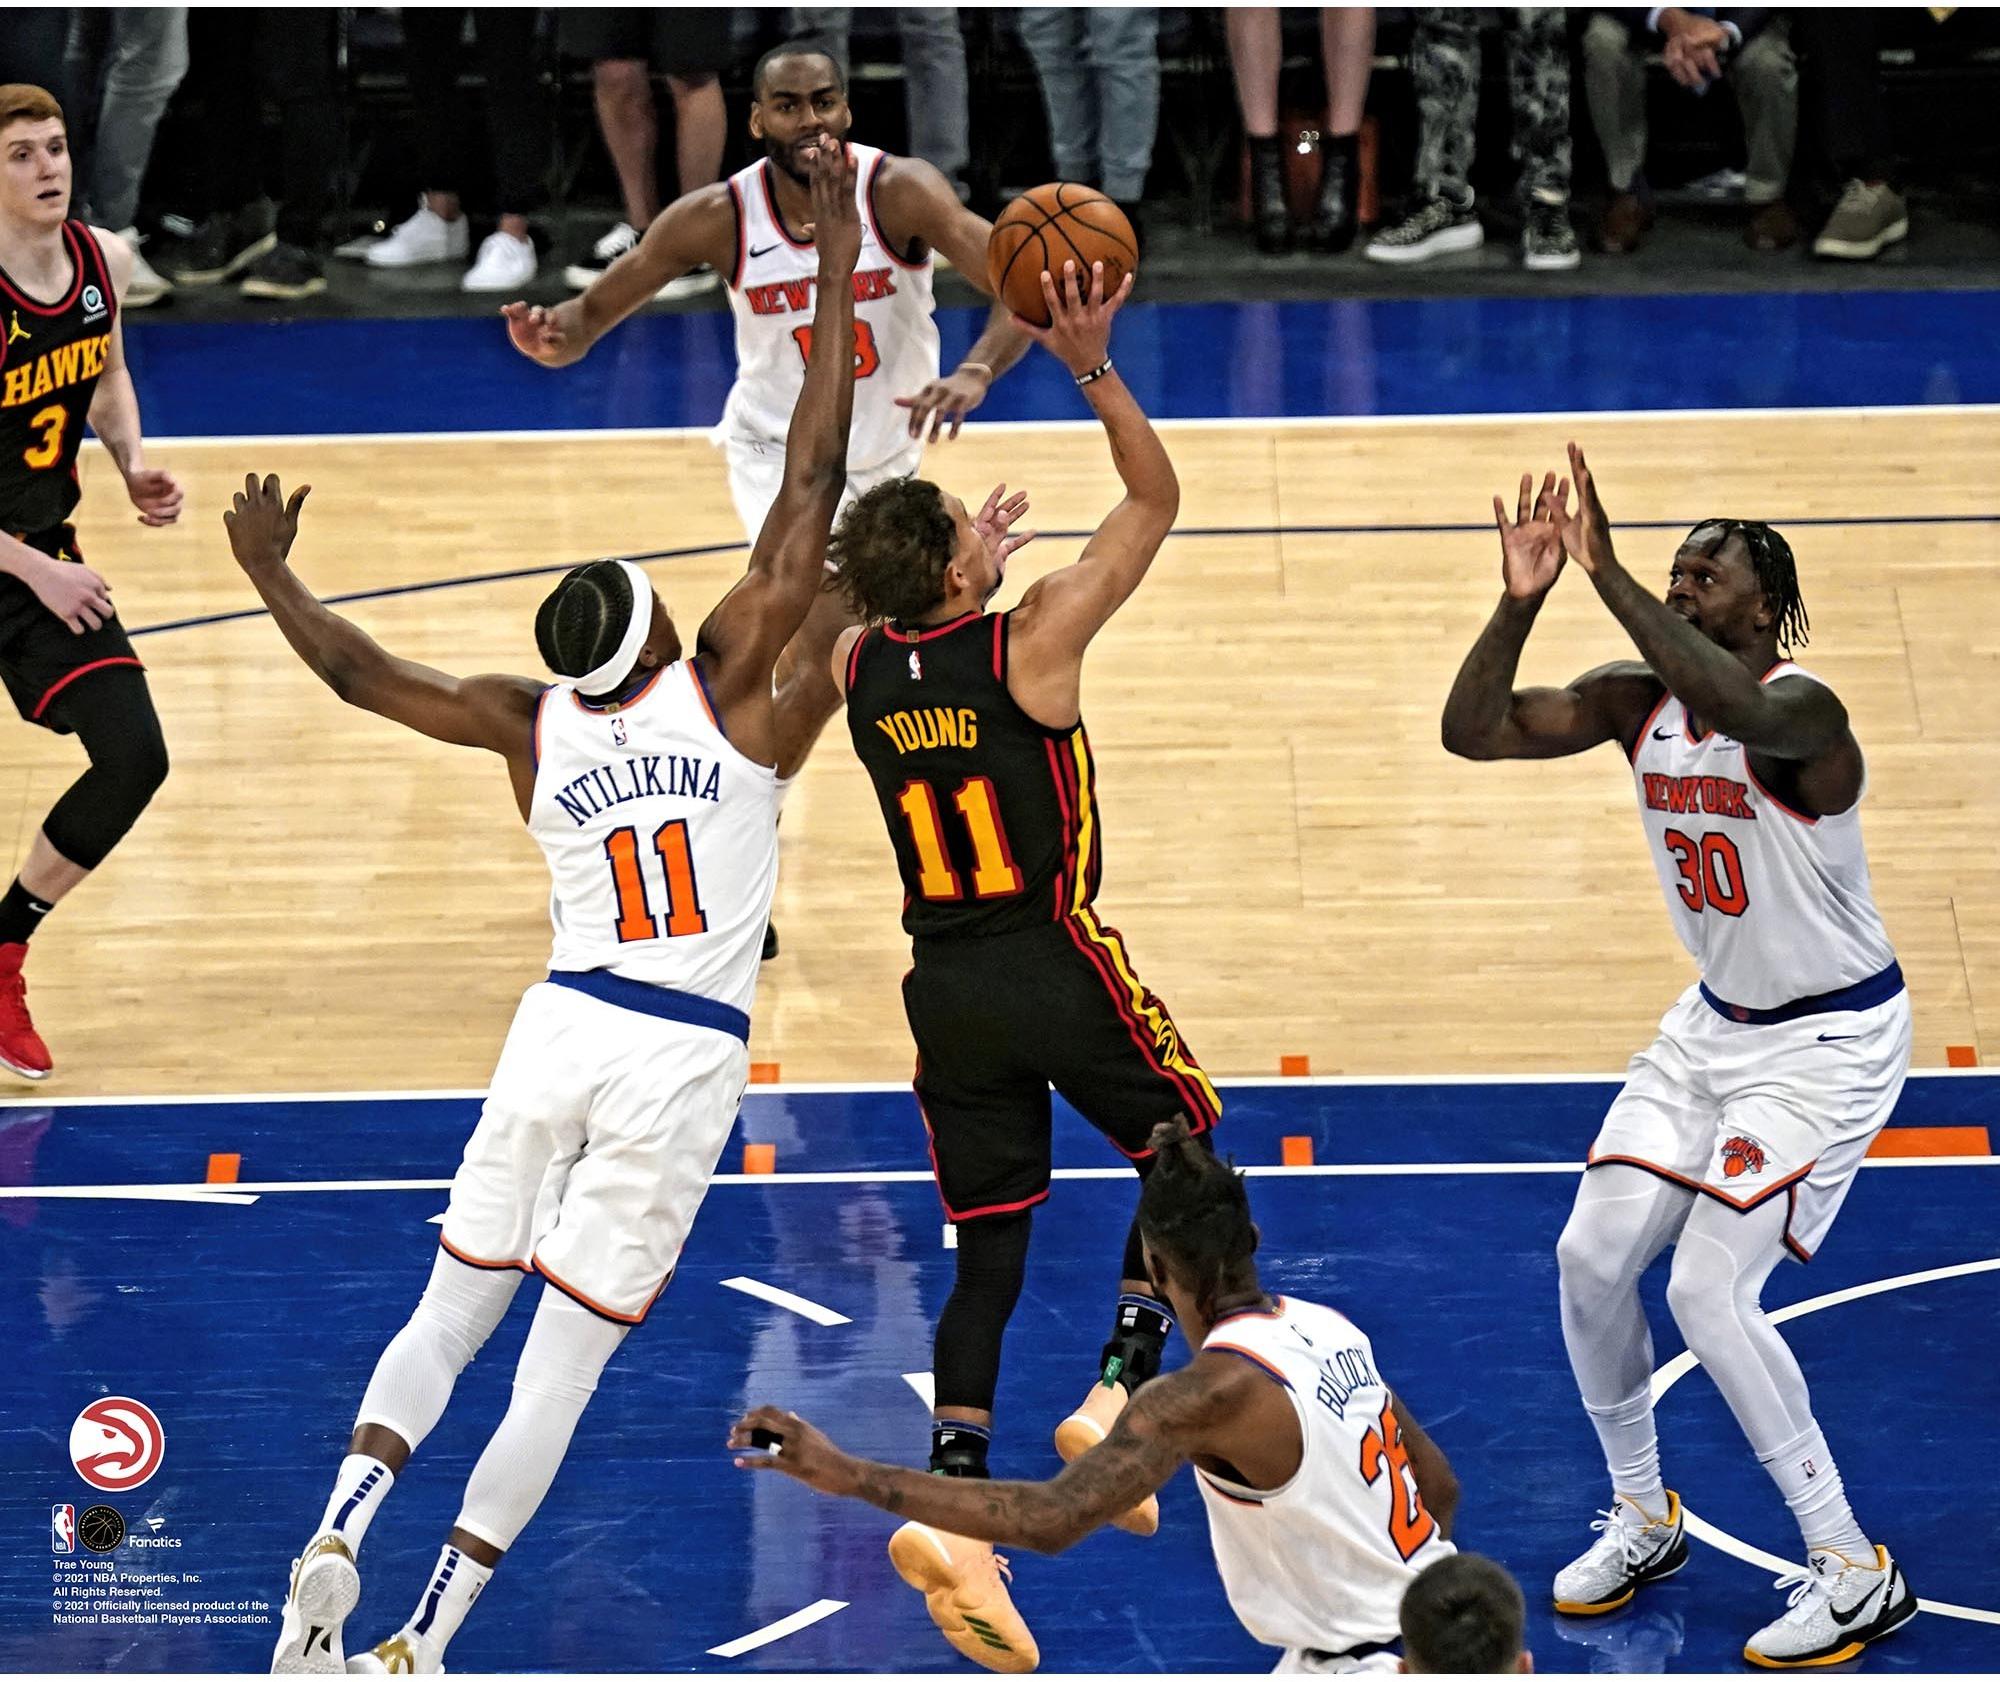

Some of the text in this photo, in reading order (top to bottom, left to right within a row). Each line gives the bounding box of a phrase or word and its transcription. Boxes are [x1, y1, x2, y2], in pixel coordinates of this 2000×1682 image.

[1, 333, 111, 408] HAWKS
[23, 403, 68, 469] 3
[876, 707, 977, 755] YOUNG
[554, 755, 721, 828] NTILIKINA
[897, 775, 1025, 901] 11
[1664, 827, 1750, 918] 30
[603, 817, 709, 944] 11
[1316, 1347, 1379, 1422] BULOCK
